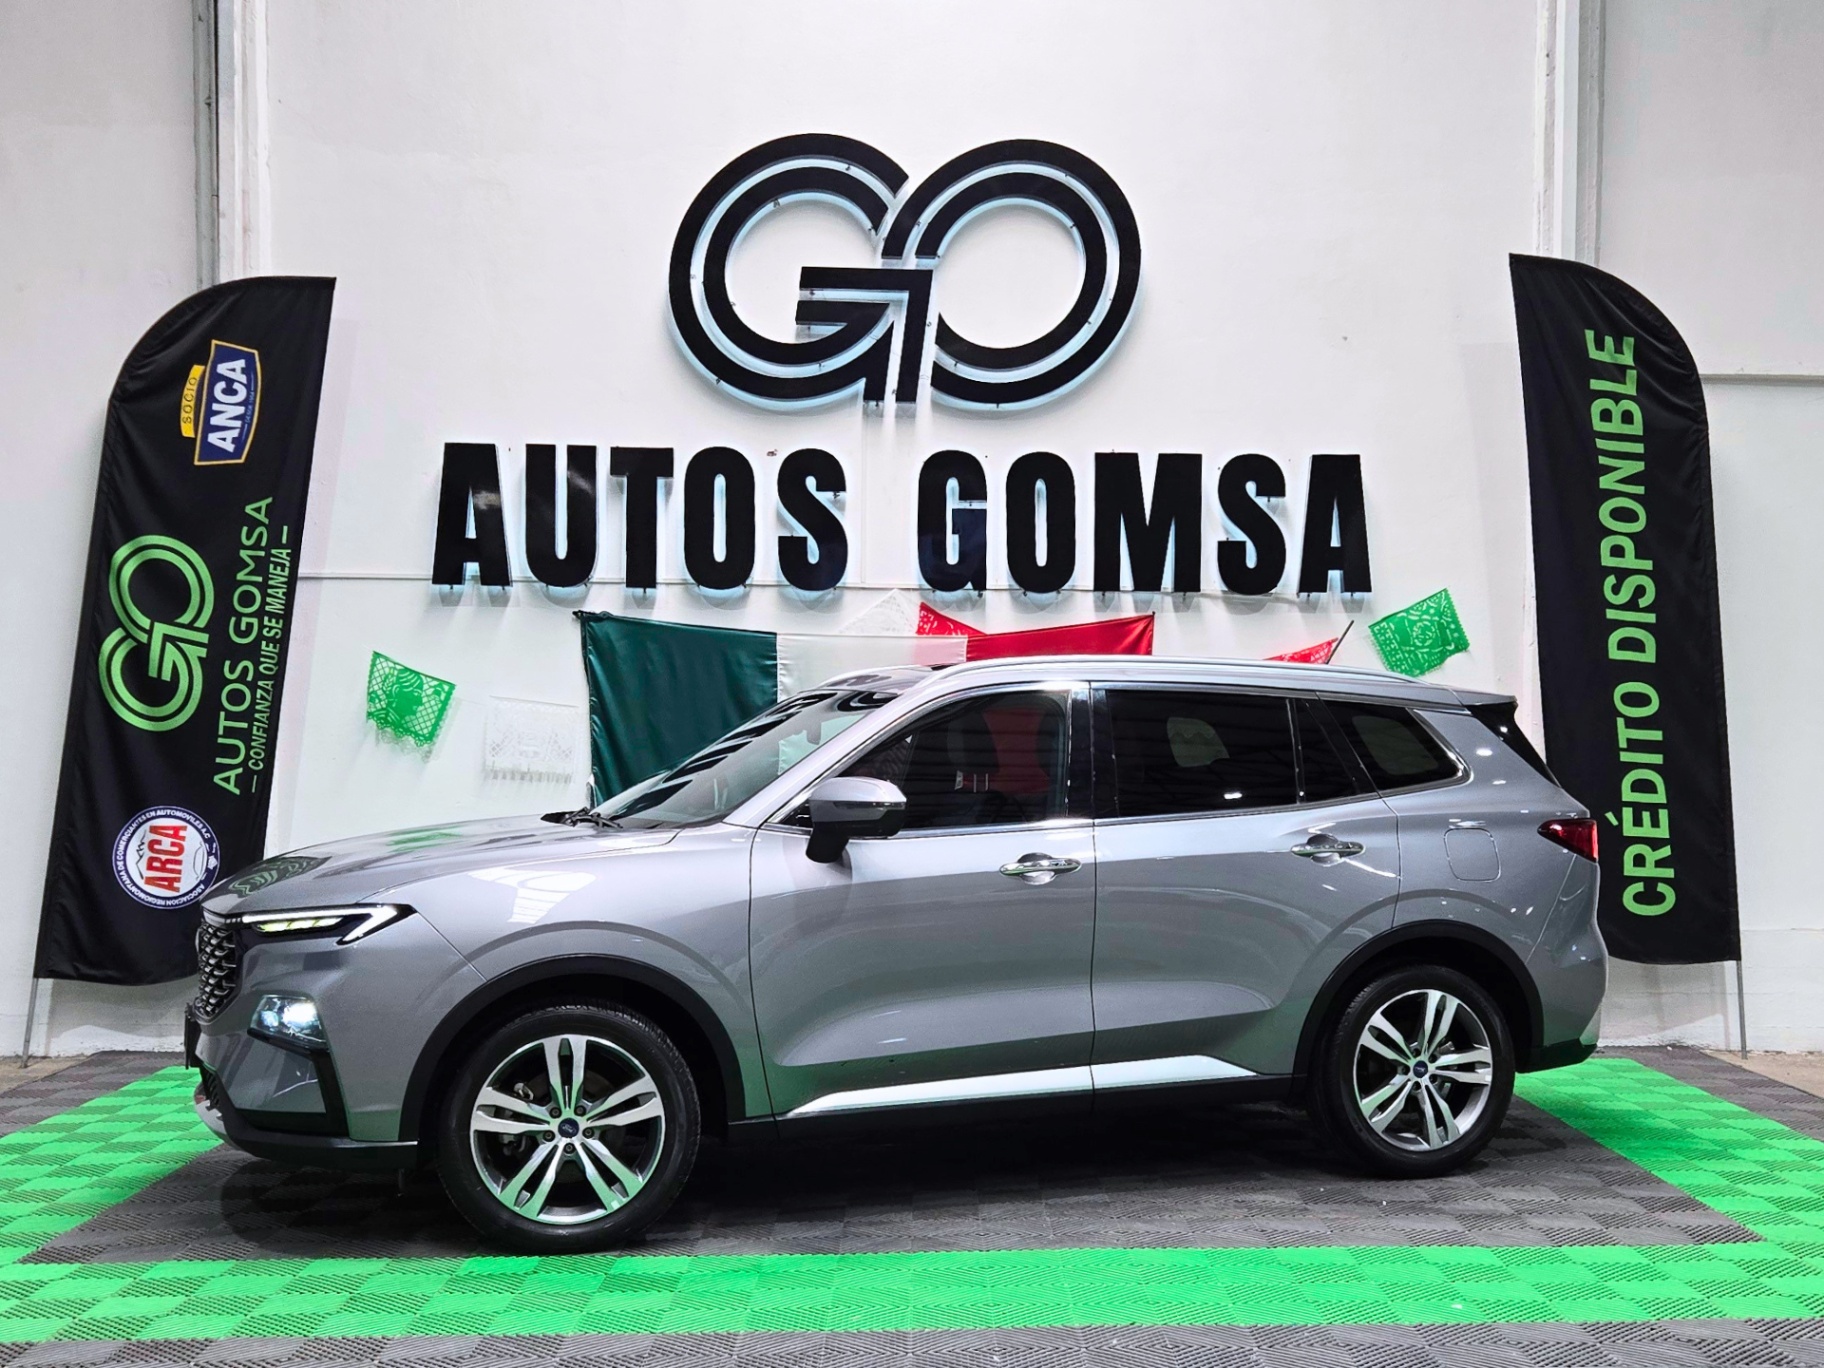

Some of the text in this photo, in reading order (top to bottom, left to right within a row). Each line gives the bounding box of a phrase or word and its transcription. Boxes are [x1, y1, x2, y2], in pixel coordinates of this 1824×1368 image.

[181, 377, 198, 425] SOCIO
[207, 359, 248, 453] ANCA
[432, 442, 1372, 594] AUTOS GOMSA
[213, 496, 273, 796] AUTOS GOMSA
[248, 548, 292, 770] CONFIANZA QUE SE MANEJA
[1584, 328, 1676, 917] CRÉDITO DISPONIBLE
[144, 825, 188, 893] ARCA
